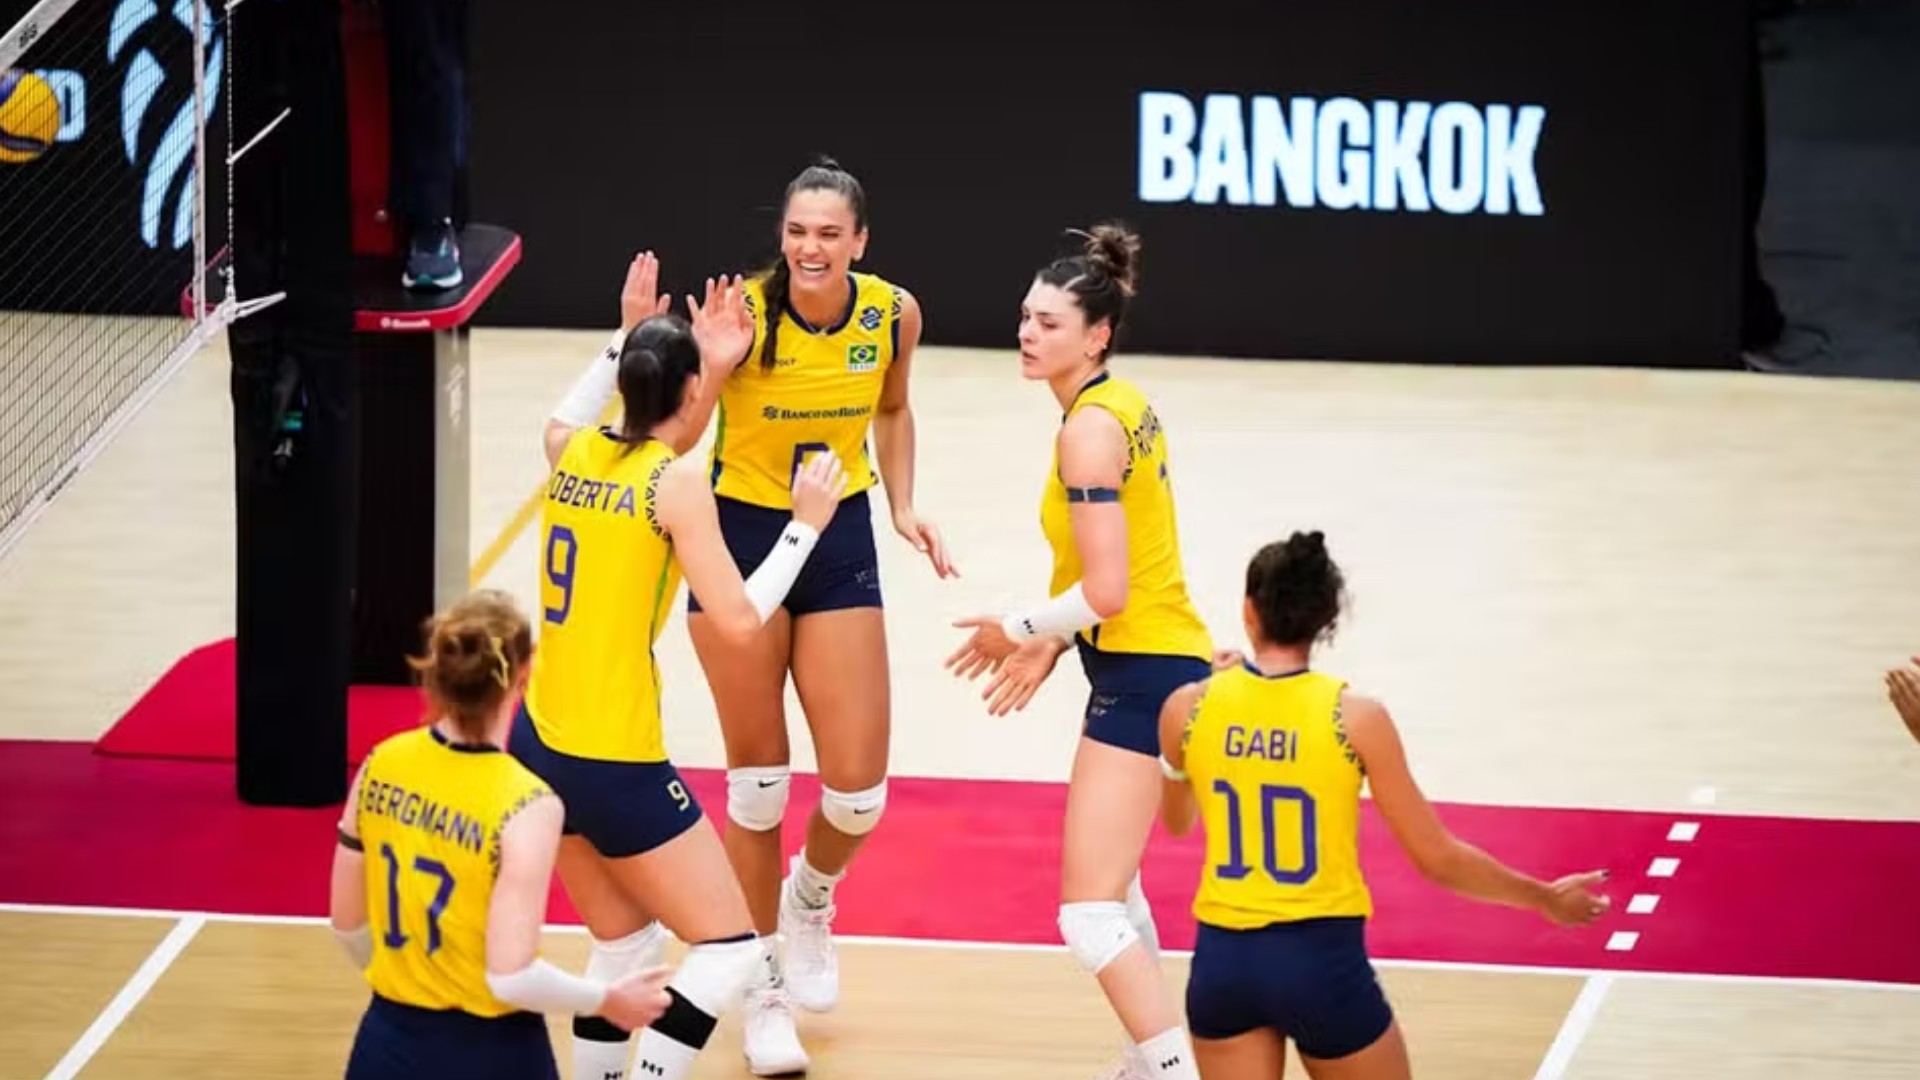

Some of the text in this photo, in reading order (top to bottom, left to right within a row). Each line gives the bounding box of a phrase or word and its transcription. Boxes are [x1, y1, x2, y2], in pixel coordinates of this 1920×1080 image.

[1138, 91, 1546, 216] BANGKOK
[549, 470, 636, 517] OBERTA
[545, 524, 578, 625] 9
[1225, 726, 1297, 763] GABI
[365, 779, 484, 855] BERGMANN
[667, 780, 690, 812] 9
[1213, 779, 1318, 885] 10
[381, 842, 456, 958] 17
